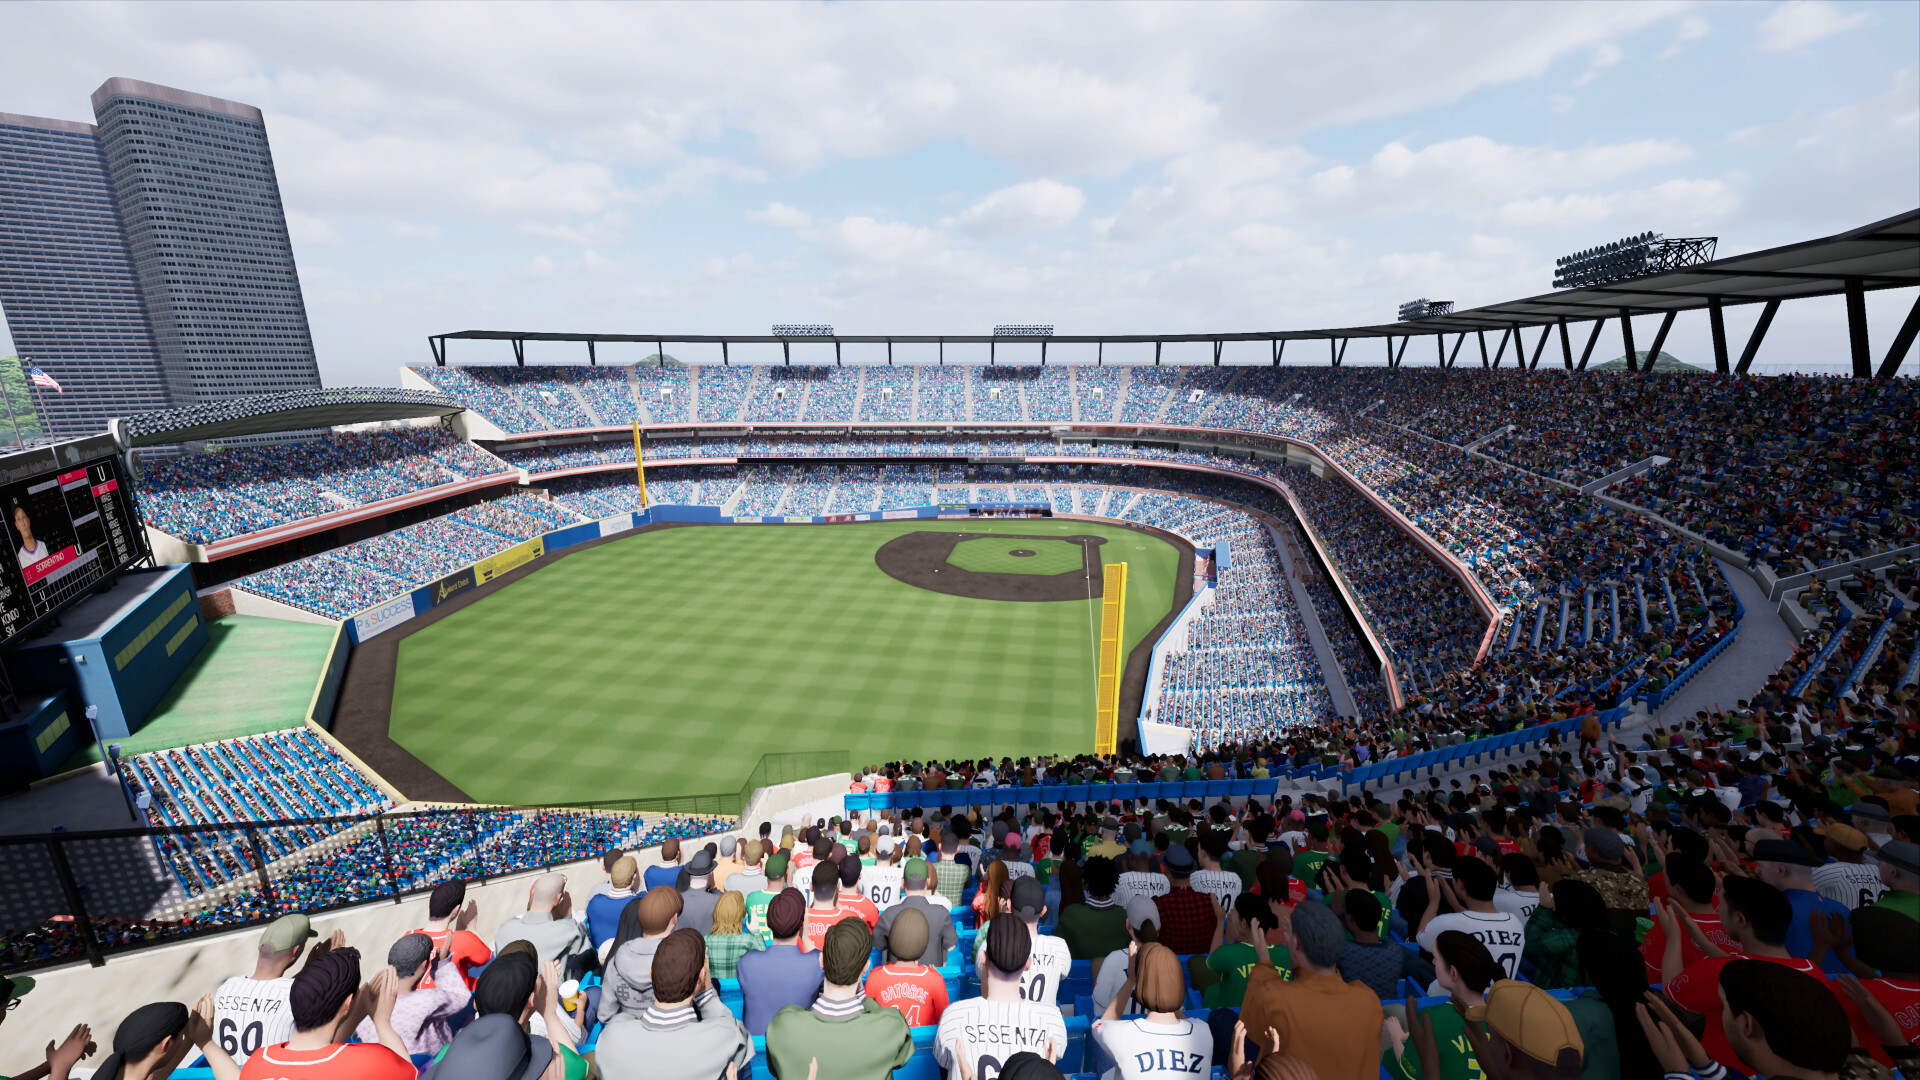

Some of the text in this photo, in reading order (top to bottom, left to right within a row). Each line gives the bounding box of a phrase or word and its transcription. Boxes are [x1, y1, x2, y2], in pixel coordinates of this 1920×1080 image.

[97, 466, 105, 481] U
[36, 552, 65, 573] SORRENTINO
[39, 590, 46, 600] U
[1, 608, 19, 626] KONDO
[356, 620, 363, 631] P
[371, 597, 413, 625] SUCCESS
[871, 885, 891, 904] 60
[1127, 881, 1164, 891] SESENTA
[1200, 880, 1237, 889] SESENTA
[881, 982, 928, 1005] GATORCE
[217, 995, 282, 1015] SESENTA
[219, 1017, 263, 1057] 60
[964, 1024, 1047, 1048] SESENTA
[1134, 1048, 1205, 1074] DIEZ
